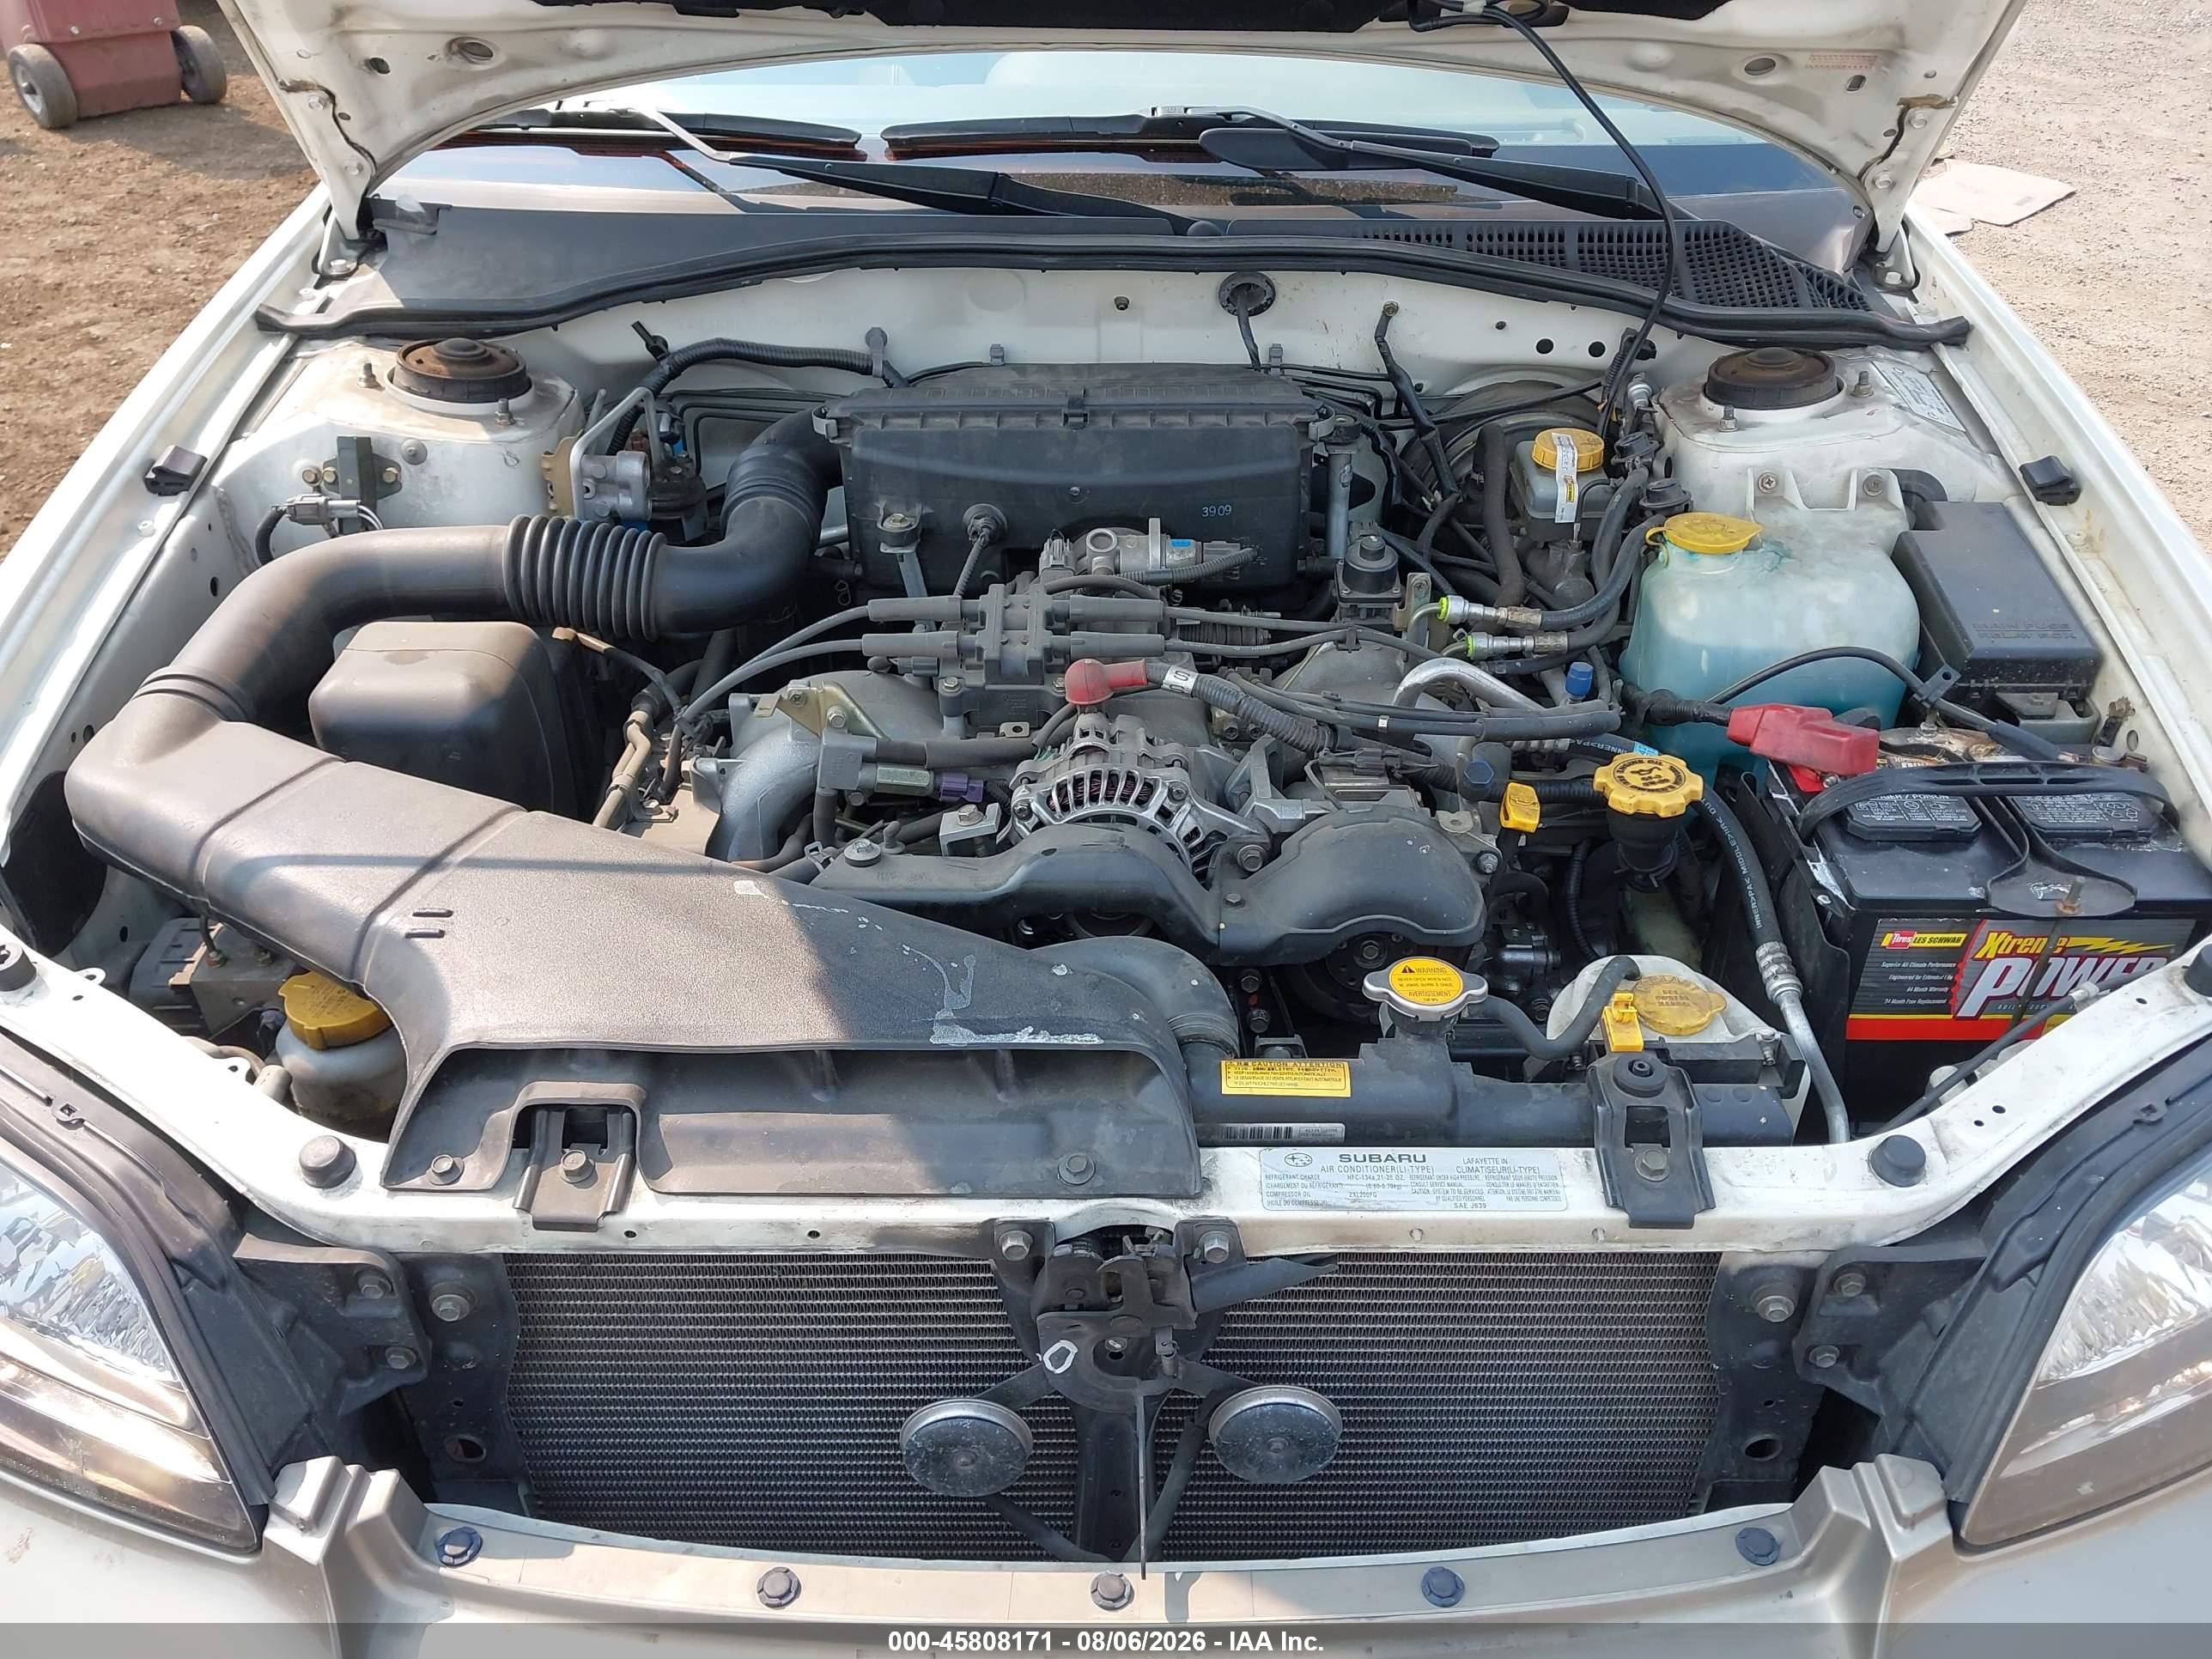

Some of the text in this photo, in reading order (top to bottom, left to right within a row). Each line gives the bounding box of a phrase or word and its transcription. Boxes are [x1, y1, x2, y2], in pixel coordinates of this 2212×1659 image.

[1912, 936, 1962, 945] LES SCHWAB
[1339, 1153, 1426, 1164] SUBARU
